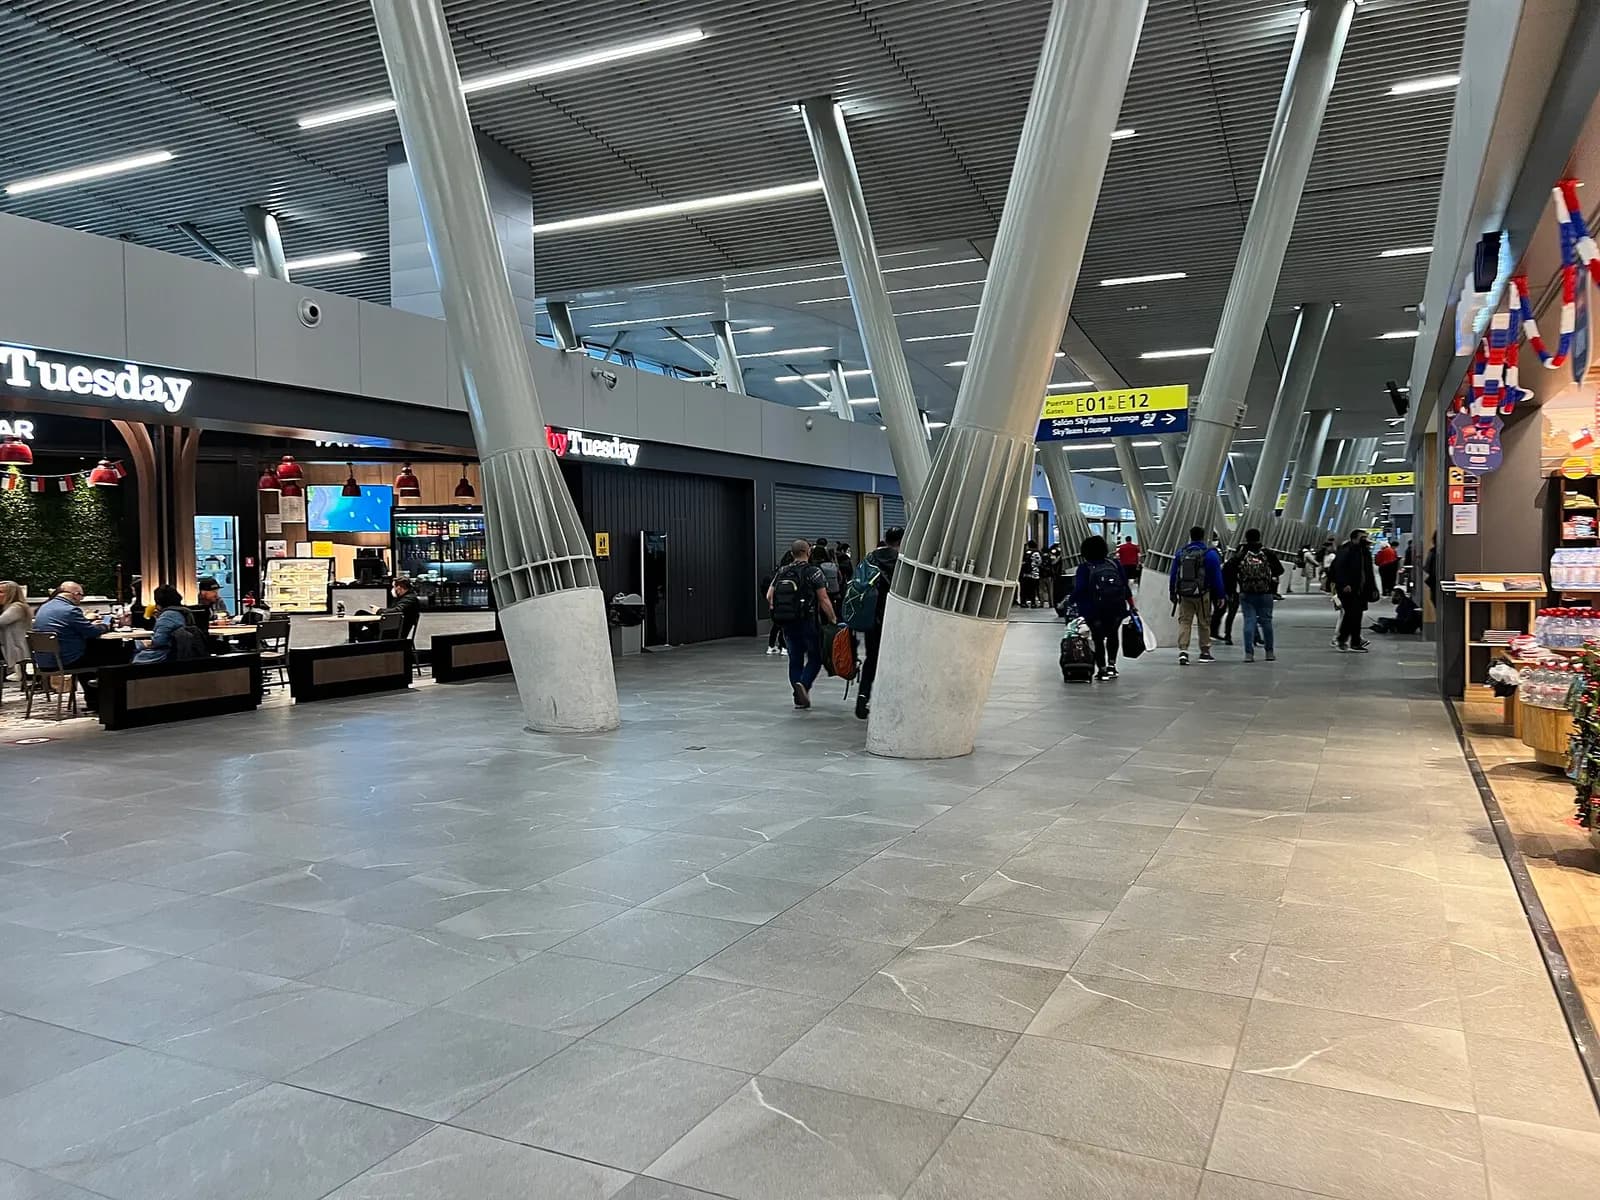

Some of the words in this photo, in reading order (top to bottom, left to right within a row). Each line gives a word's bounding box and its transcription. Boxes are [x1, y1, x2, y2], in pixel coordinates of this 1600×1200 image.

[0, 347, 192, 413] Tuesday
[1076, 398, 1106, 412] E01
[1118, 394, 1150, 410] E12
[1110, 416, 1140, 424] Lounge
[1084, 426, 1112, 434] Lounge
[567, 430, 640, 466] Tuesday
